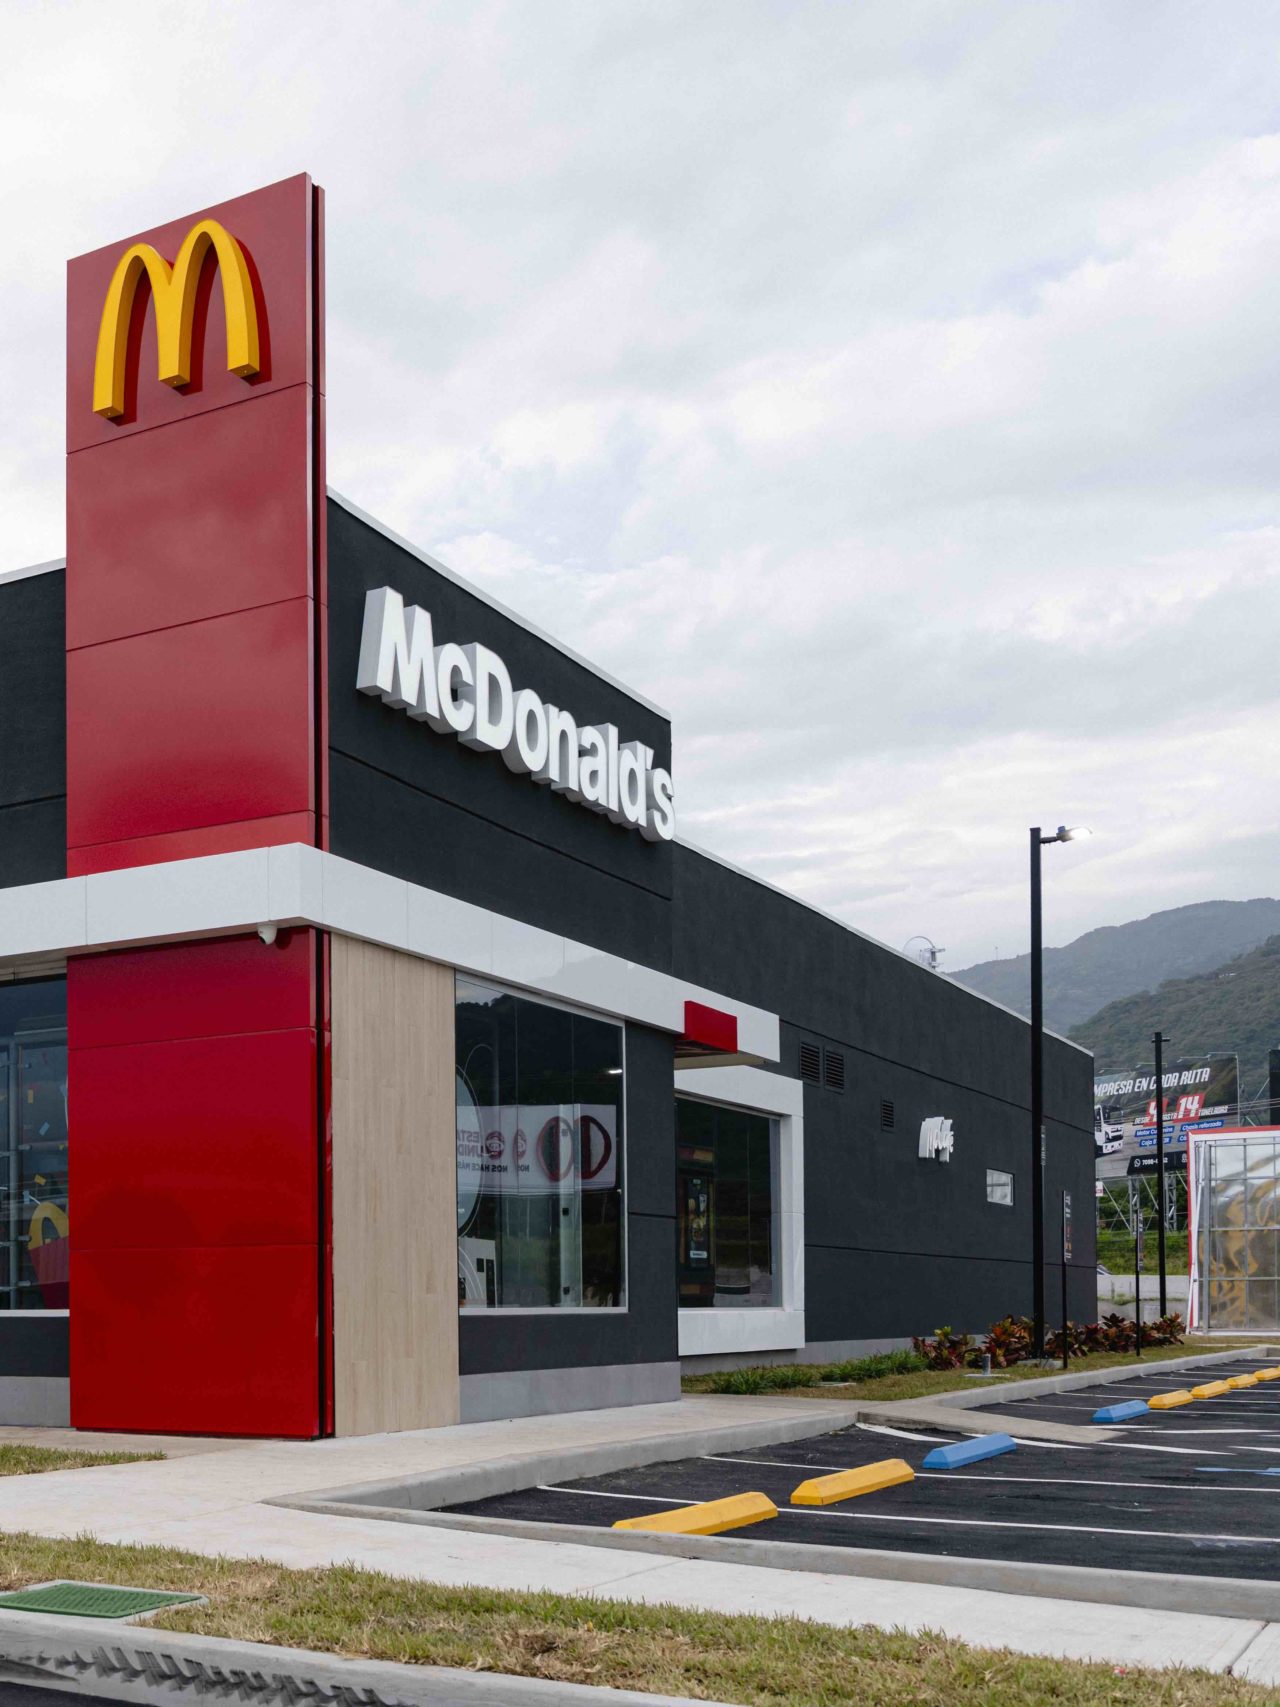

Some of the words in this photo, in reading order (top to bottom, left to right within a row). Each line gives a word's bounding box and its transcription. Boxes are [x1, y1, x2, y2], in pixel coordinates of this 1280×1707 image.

[356, 586, 676, 841] McDonald's
[1094, 1079, 1133, 1097] MPRESA
[1134, 1076, 1150, 1092] EN
[1150, 1072, 1179, 1090] CDA
[1180, 1067, 1211, 1085] RUTA
[1177, 1096, 1200, 1118] 14
